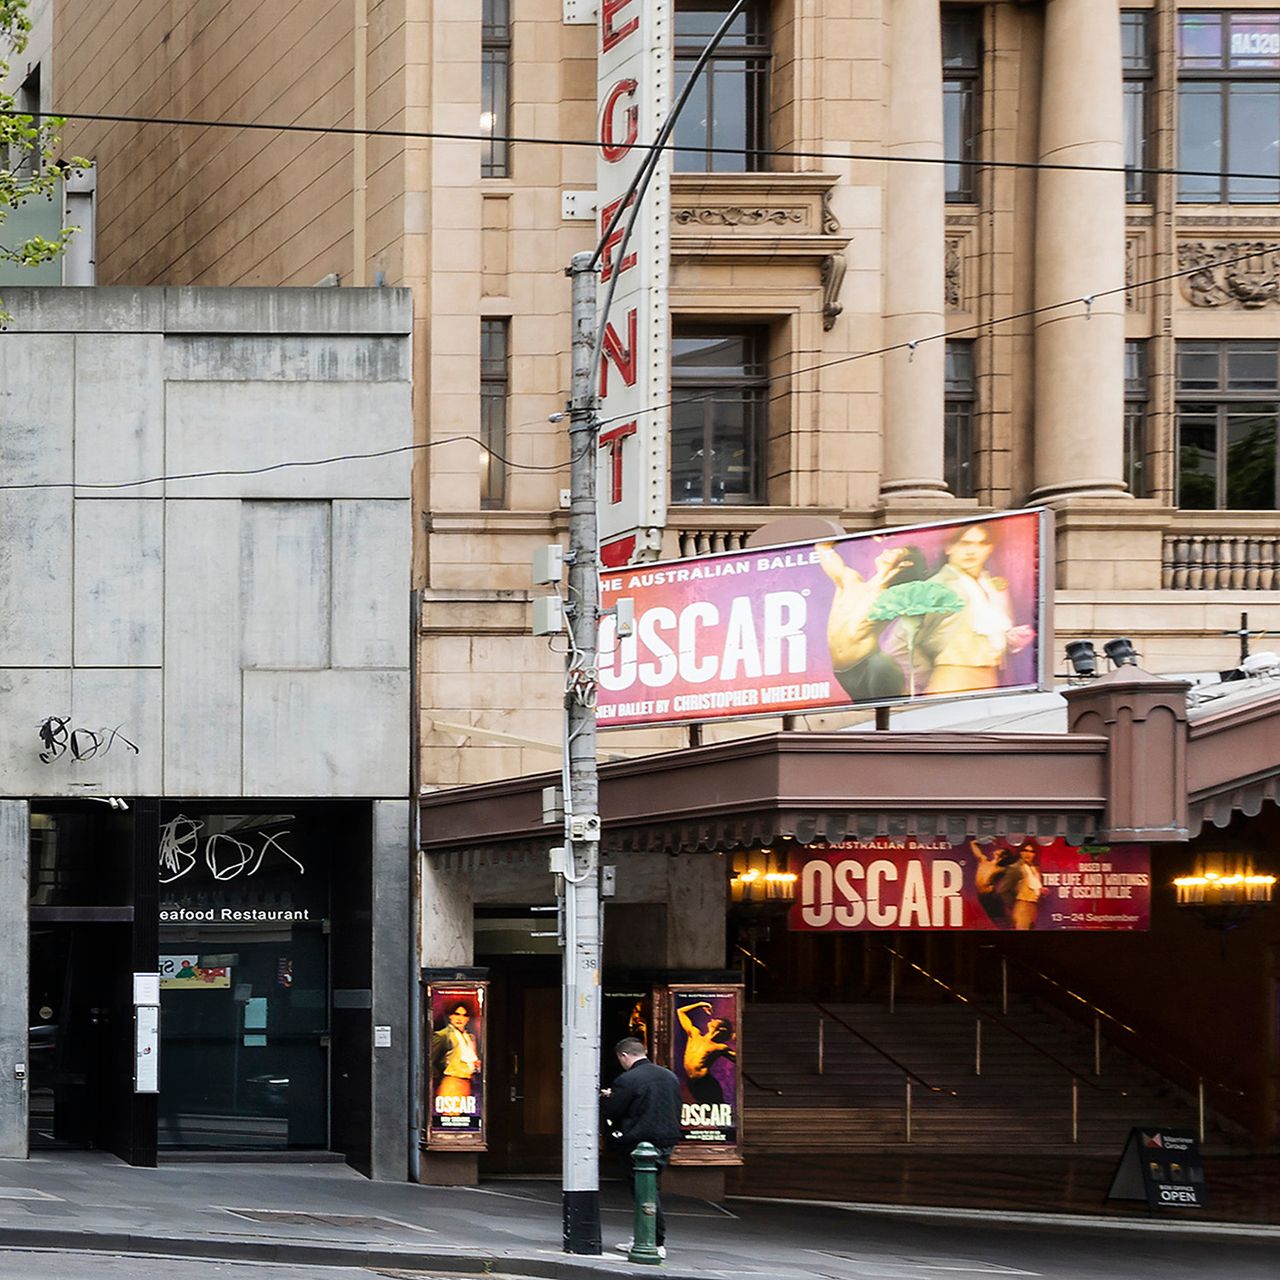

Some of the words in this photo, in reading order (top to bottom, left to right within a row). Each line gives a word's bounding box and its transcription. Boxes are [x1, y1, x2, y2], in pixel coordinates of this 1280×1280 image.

[599, 578, 622, 592] HE
[628, 561, 750, 589] AUSTRALIAN
[757, 550, 832, 571] BALLET
[618, 700, 654, 717] BALLET
[656, 699, 671, 714] BY
[673, 688, 759, 712] CHRISTOPHER
[761, 681, 831, 705] WHEELDON
[829, 841, 906, 850] AUSTRALIAN
[1042, 873, 1060, 886] THE
[1062, 873, 1081, 886] LIFE
[1083, 873, 1102, 886] AND
[1105, 873, 1149, 886] WRITINGS
[1058, 886, 1071, 899] OF
[1073, 886, 1102, 899] OSCAR
[1105, 886, 1132, 899] WILDE
[159, 908, 214, 920] eafood
[221, 908, 309, 920] Restaurant
[1086, 913, 1140, 924] September
[435, 1095, 476, 1114] OSCAR
[680, 1103, 733, 1126] OSCAR
[1161, 1190, 1197, 1202] OPEN
